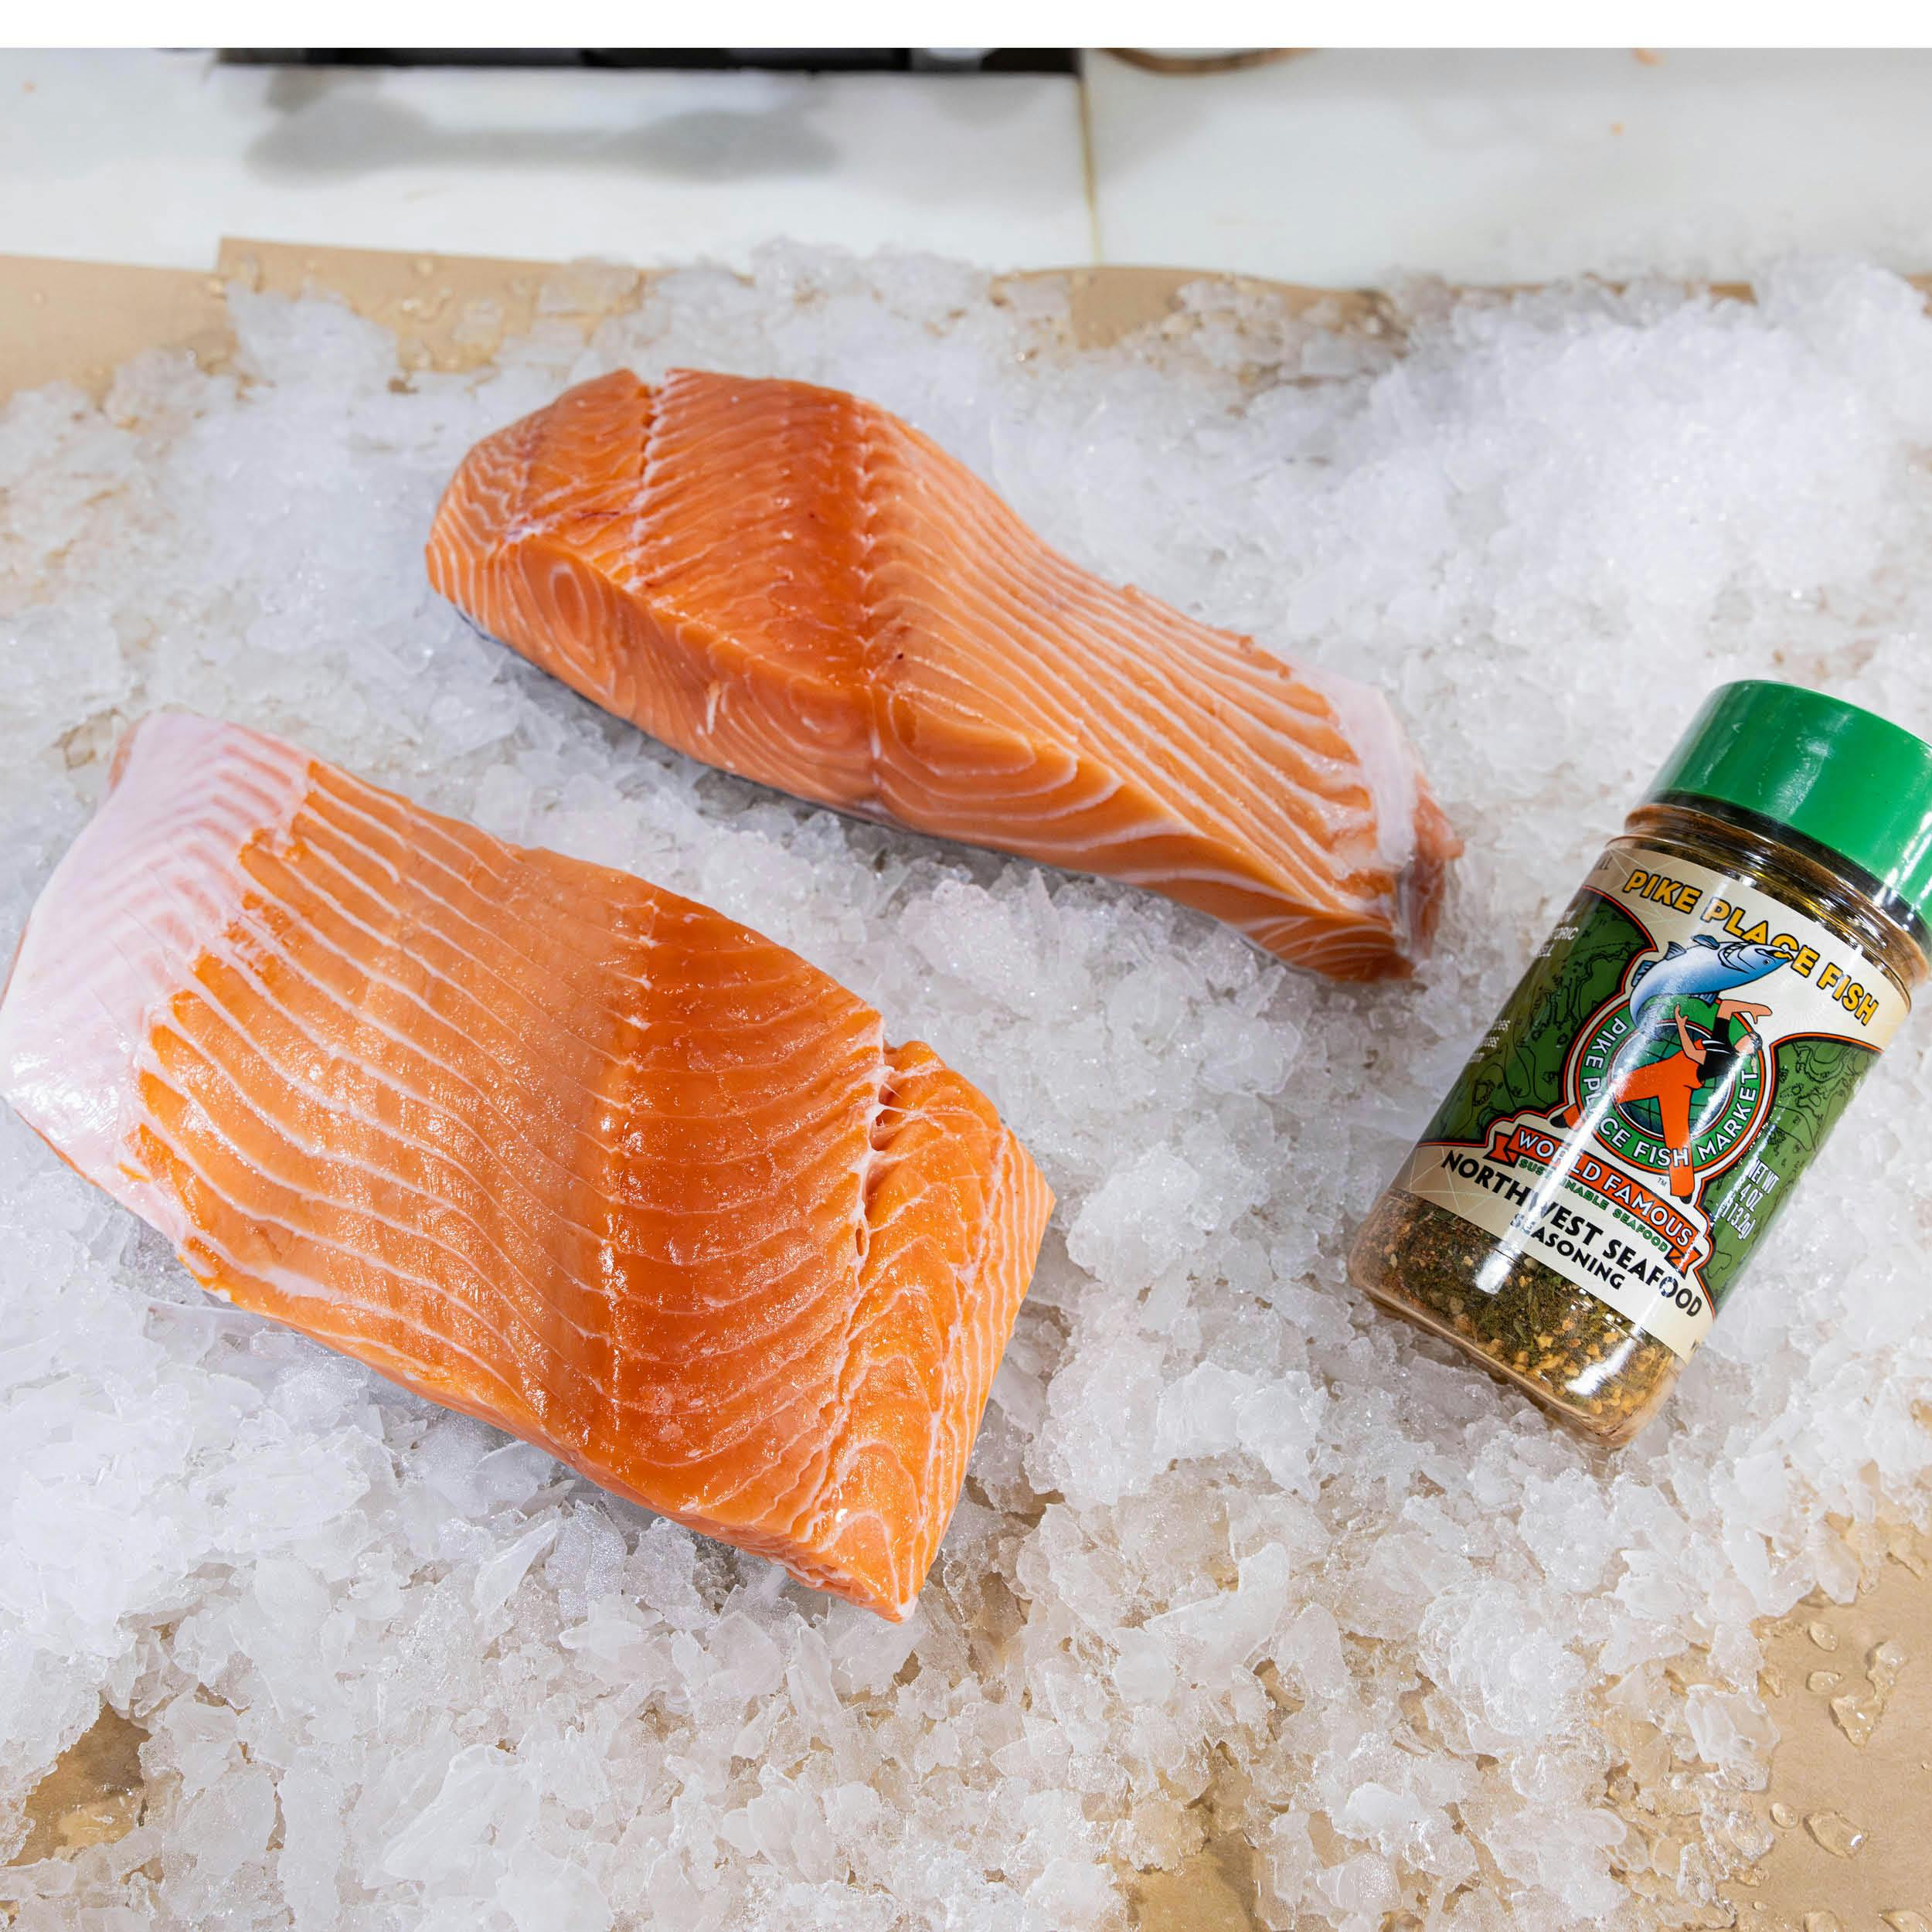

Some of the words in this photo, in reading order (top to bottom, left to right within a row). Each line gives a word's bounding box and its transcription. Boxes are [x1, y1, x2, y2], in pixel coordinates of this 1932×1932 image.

[1622, 869, 1703, 914] PIKE
[1700, 896, 1821, 978] PLACE
[1816, 962, 1879, 1026] FISH
[1585, 1017, 1628, 1070] PIKE
[1583, 1076, 1632, 1148] PLCE
[1697, 1070, 1759, 1162] MARKET
[1633, 1140, 1689, 1168] FISH
[1761, 1170, 1780, 1194] WT
[1519, 1158, 1610, 1211] SUSINABLE
[1612, 1208, 1668, 1253] SEAFOOD
[1602, 1173, 1693, 1247] FAMOUS
[1716, 1193, 1757, 1240] 113.2g)
[1739, 1182, 1752, 1202] 4
[1746, 1188, 1764, 1213] OZ
[1602, 1239, 1702, 1317] SEAFOOD
